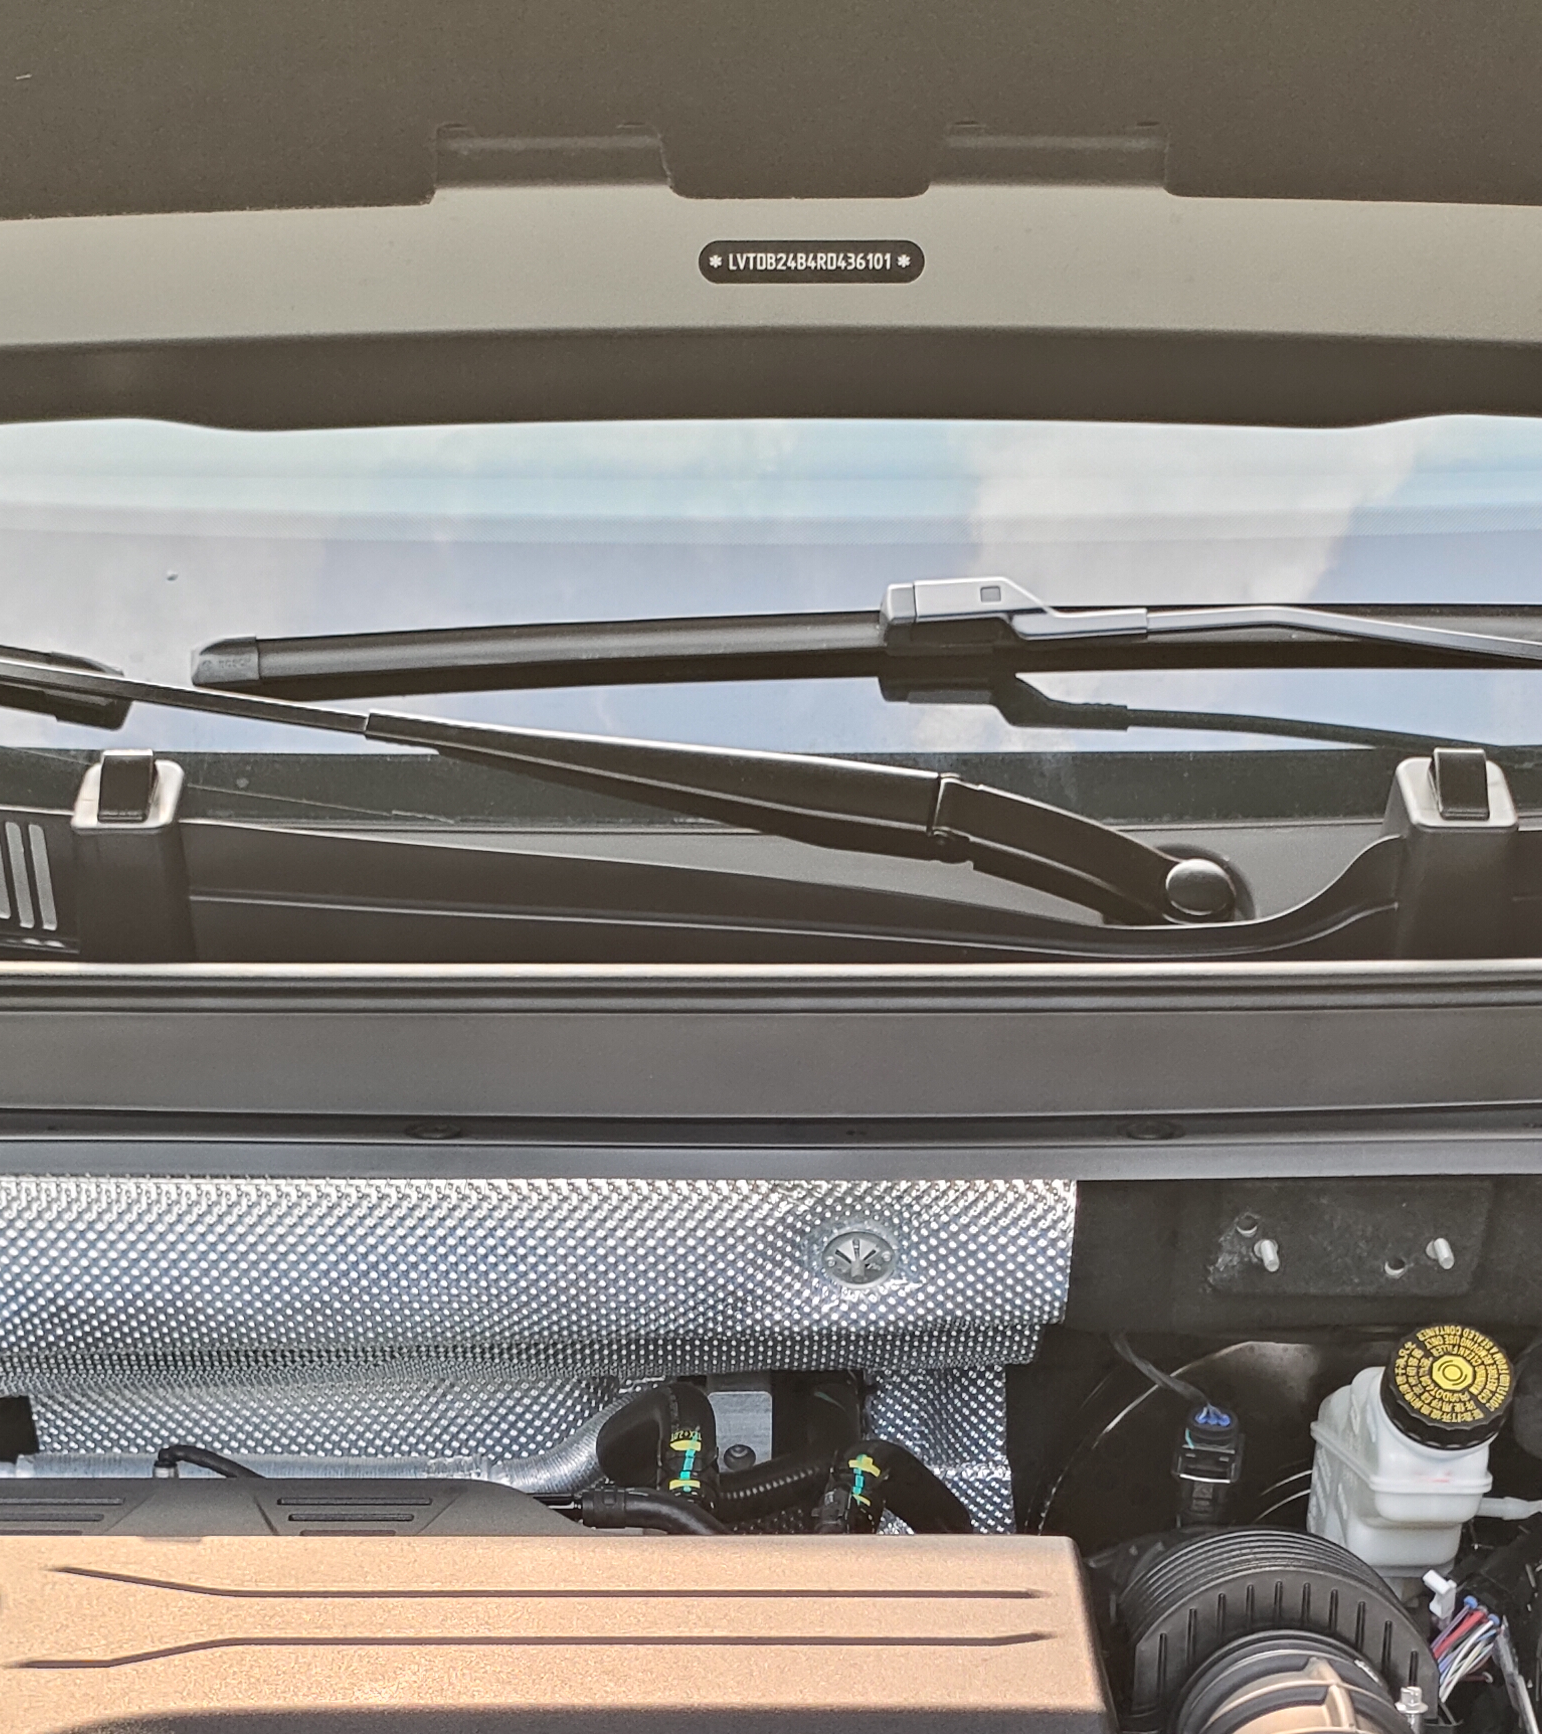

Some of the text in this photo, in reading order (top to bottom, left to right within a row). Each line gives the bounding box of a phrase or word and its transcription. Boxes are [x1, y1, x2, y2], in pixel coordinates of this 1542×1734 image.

[728, 252, 892, 271] LVTDB24B4RD436101
[1416, 1326, 1461, 1341] CONTAINER
[1425, 1336, 1443, 1349] ONLY
[1444, 1335, 1460, 1344] USE
[1463, 1328, 1494, 1349] SEALED
[1430, 1346, 1457, 1356] FILLER
[1458, 1348, 1481, 1366] CLEAN
[1461, 1336, 1494, 1364] REMOVING
[1493, 1352, 1509, 1373] FROM
